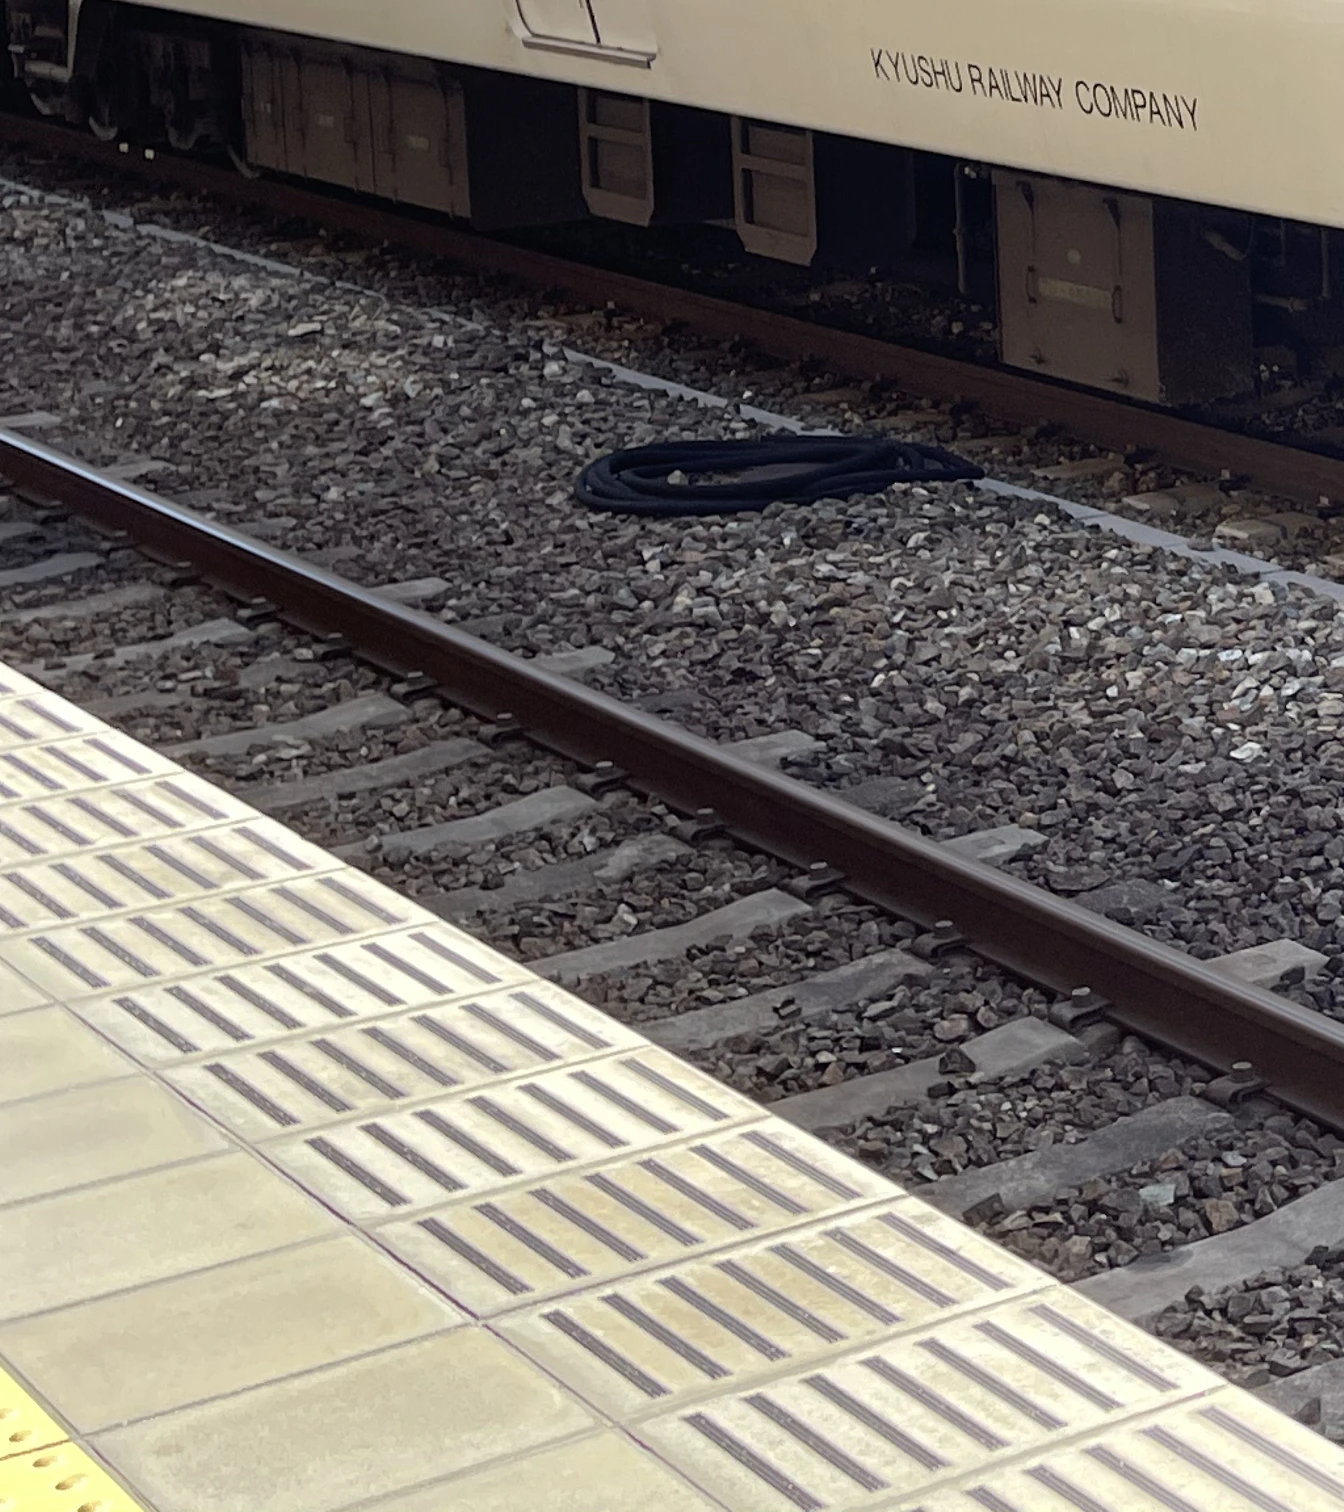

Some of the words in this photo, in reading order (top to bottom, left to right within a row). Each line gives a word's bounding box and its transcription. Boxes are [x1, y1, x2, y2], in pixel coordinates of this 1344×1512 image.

[870, 48, 963, 93] KYUSHU
[967, 64, 1063, 110] RAILWAY
[1075, 80, 1198, 131] COMPANY
